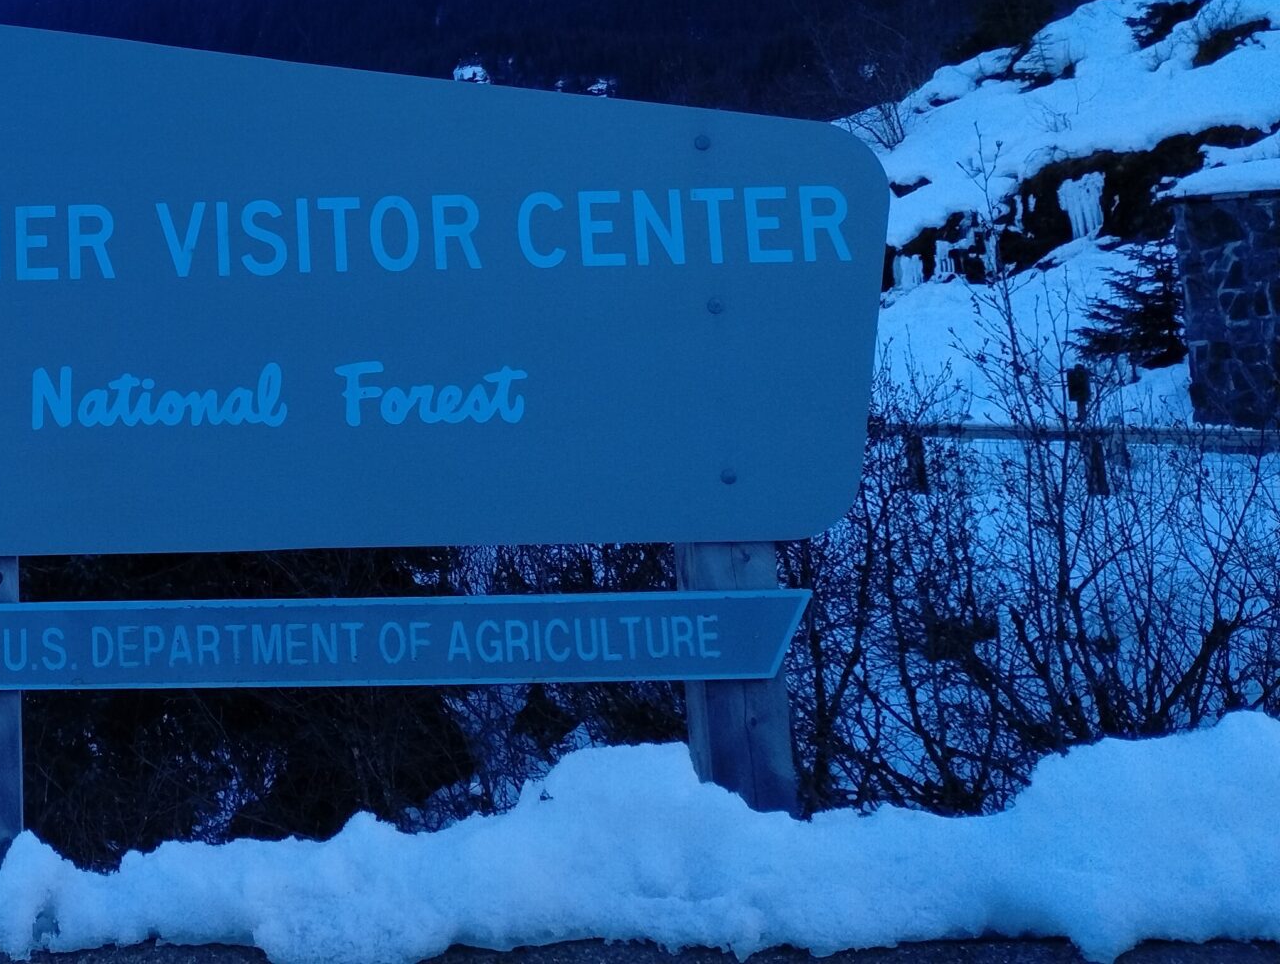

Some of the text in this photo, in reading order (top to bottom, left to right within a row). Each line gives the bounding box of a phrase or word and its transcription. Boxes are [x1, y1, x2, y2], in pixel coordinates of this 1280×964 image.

[155, 194, 483, 277] VISITOR
[517, 185, 852, 269] CENTER
[31, 362, 288, 431] National
[334, 360, 528, 427] Forest
[3, 614, 720, 672] U.S. DEPARTMENT OF AGRICULTURE
